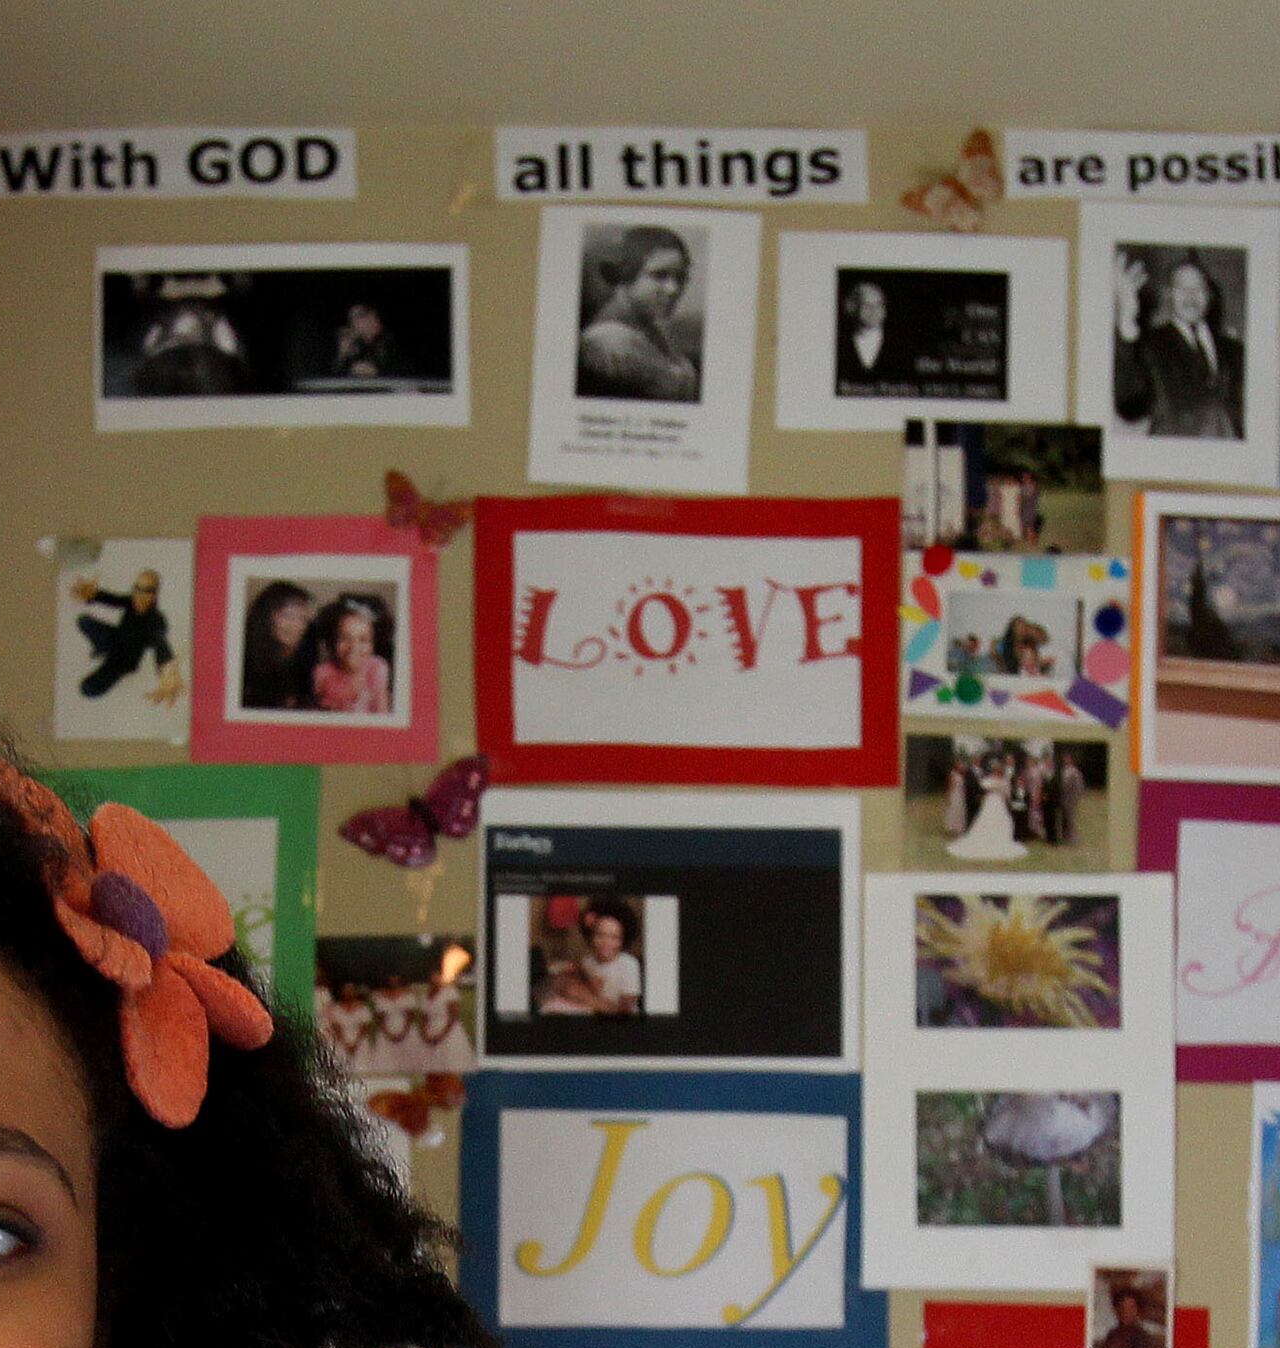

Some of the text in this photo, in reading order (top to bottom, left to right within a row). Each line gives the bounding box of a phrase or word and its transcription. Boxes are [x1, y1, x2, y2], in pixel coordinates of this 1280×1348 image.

[185, 135, 341, 188] GOD
[513, 138, 842, 198] all things
[1017, 154, 1106, 186] are
[514, 577, 859, 672] LOVE
[515, 1118, 844, 1327] Joy
